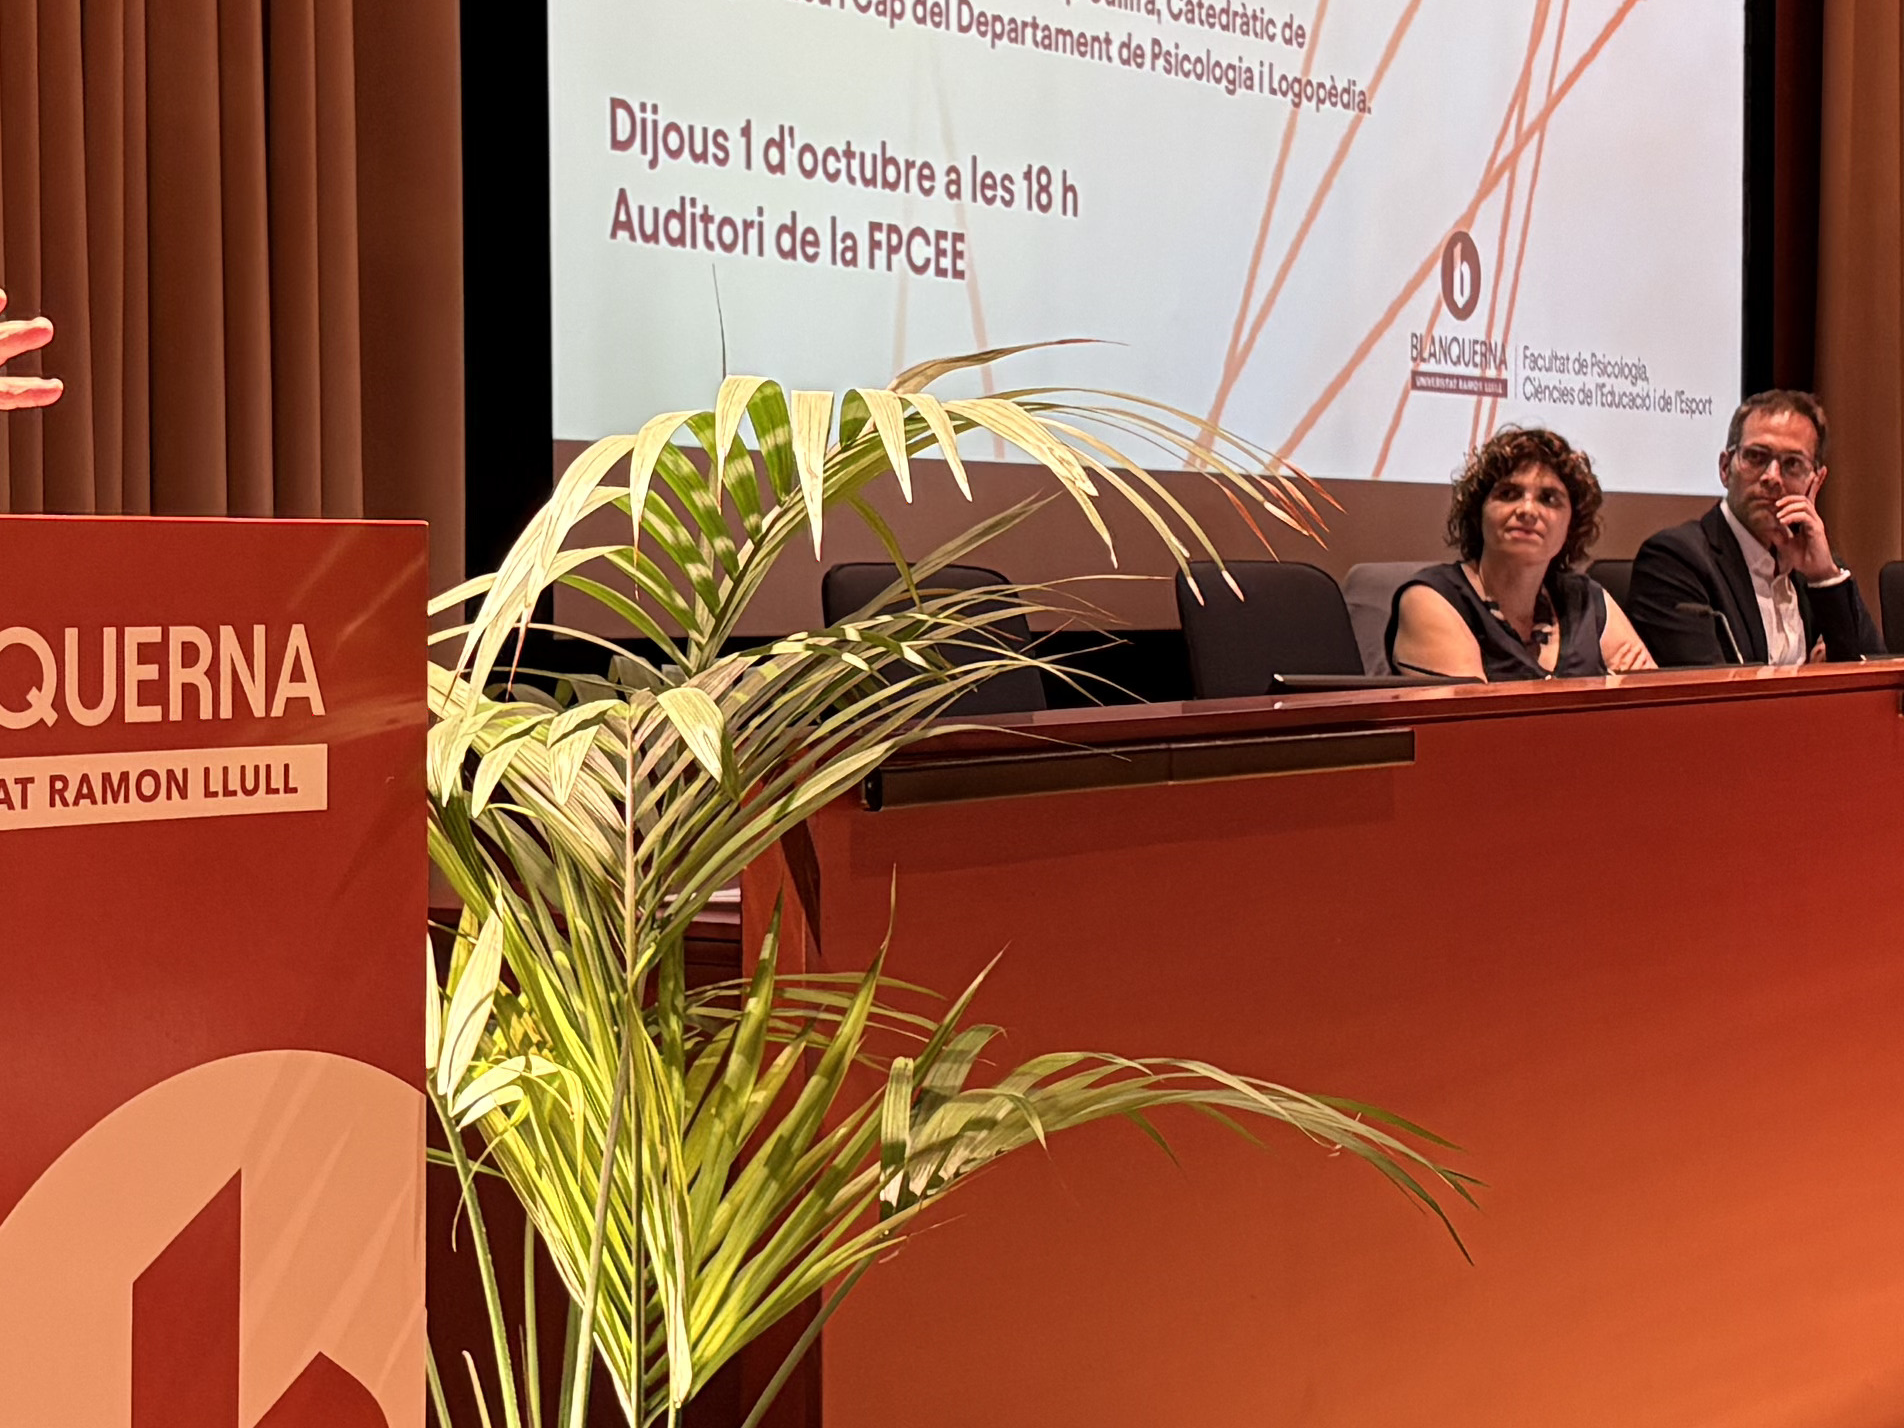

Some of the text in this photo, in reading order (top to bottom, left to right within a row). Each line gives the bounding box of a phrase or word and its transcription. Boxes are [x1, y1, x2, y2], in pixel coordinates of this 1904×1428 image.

[1280, 13, 1307, 50] de
[1117, 31, 1146, 70] de
[1150, 37, 1255, 96] Psicologia
[1258, 59, 1265, 94] i
[1268, 61, 1373, 115] Logopèdia.
[608, 96, 1079, 218] Dijous 1 d'octubre a les 18 h
[609, 186, 967, 281] Auditori de la FPCEE
[1410, 331, 1508, 371] BLANQUERNA
[1522, 345, 1650, 387] Facultat de Psicologia,
[1522, 375, 1575, 406] Ciències
[1577, 381, 1594, 407] de
[1658, 388, 1673, 414] de
[48, 768, 190, 809] RAMON
[201, 762, 299, 800] LLULL
